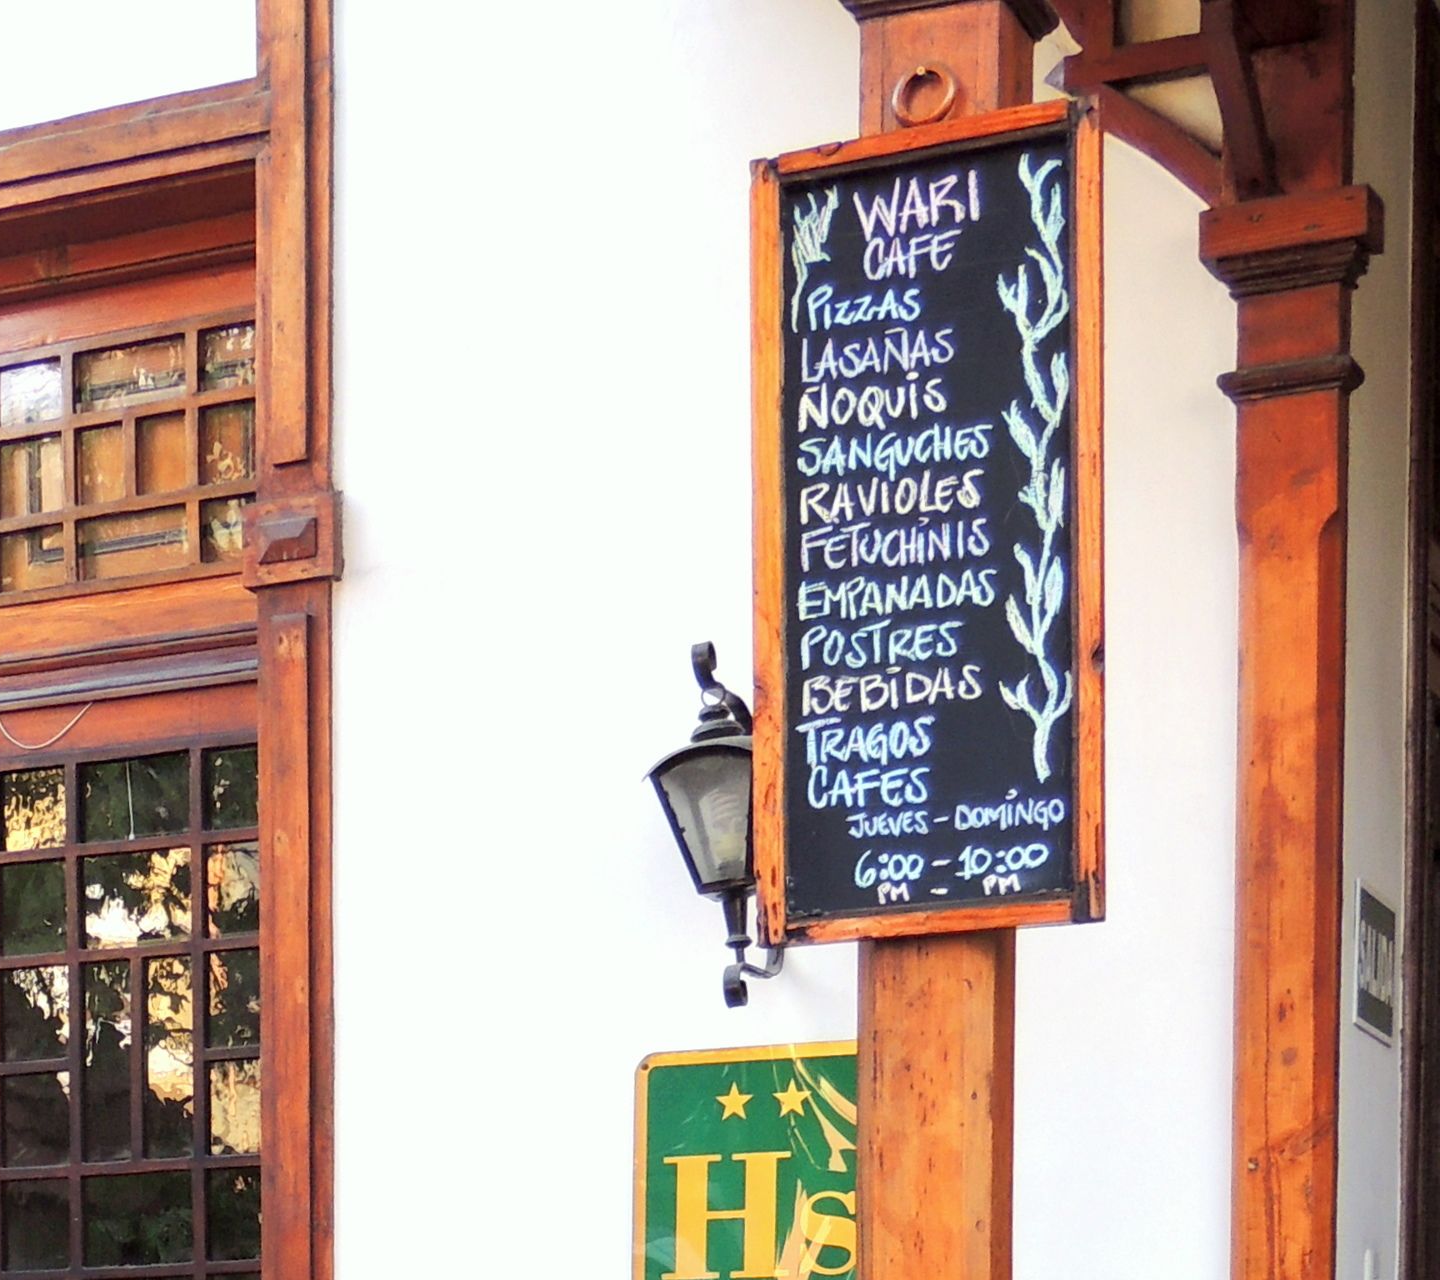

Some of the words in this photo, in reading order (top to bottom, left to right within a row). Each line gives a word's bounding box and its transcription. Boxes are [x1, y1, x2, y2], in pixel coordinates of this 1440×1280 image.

[853, 169, 981, 241] WARI
[863, 230, 963, 280] CAFE
[801, 327, 955, 383] LASAÑAS
[796, 423, 993, 481] SANGUCHES
[800, 468, 985, 525] RAVIOLES
[797, 568, 998, 621] EMPANADAS
[800, 620, 964, 670] POSTRES
[795, 716, 936, 768] TRAGOS
[807, 765, 932, 809] CAFES
[846, 810, 929, 840] JUEVES
[855, 849, 925, 889] 6:00
[955, 843, 1049, 880] 10:00
[878, 882, 910, 905] PM
[982, 873, 1021, 896] PM
